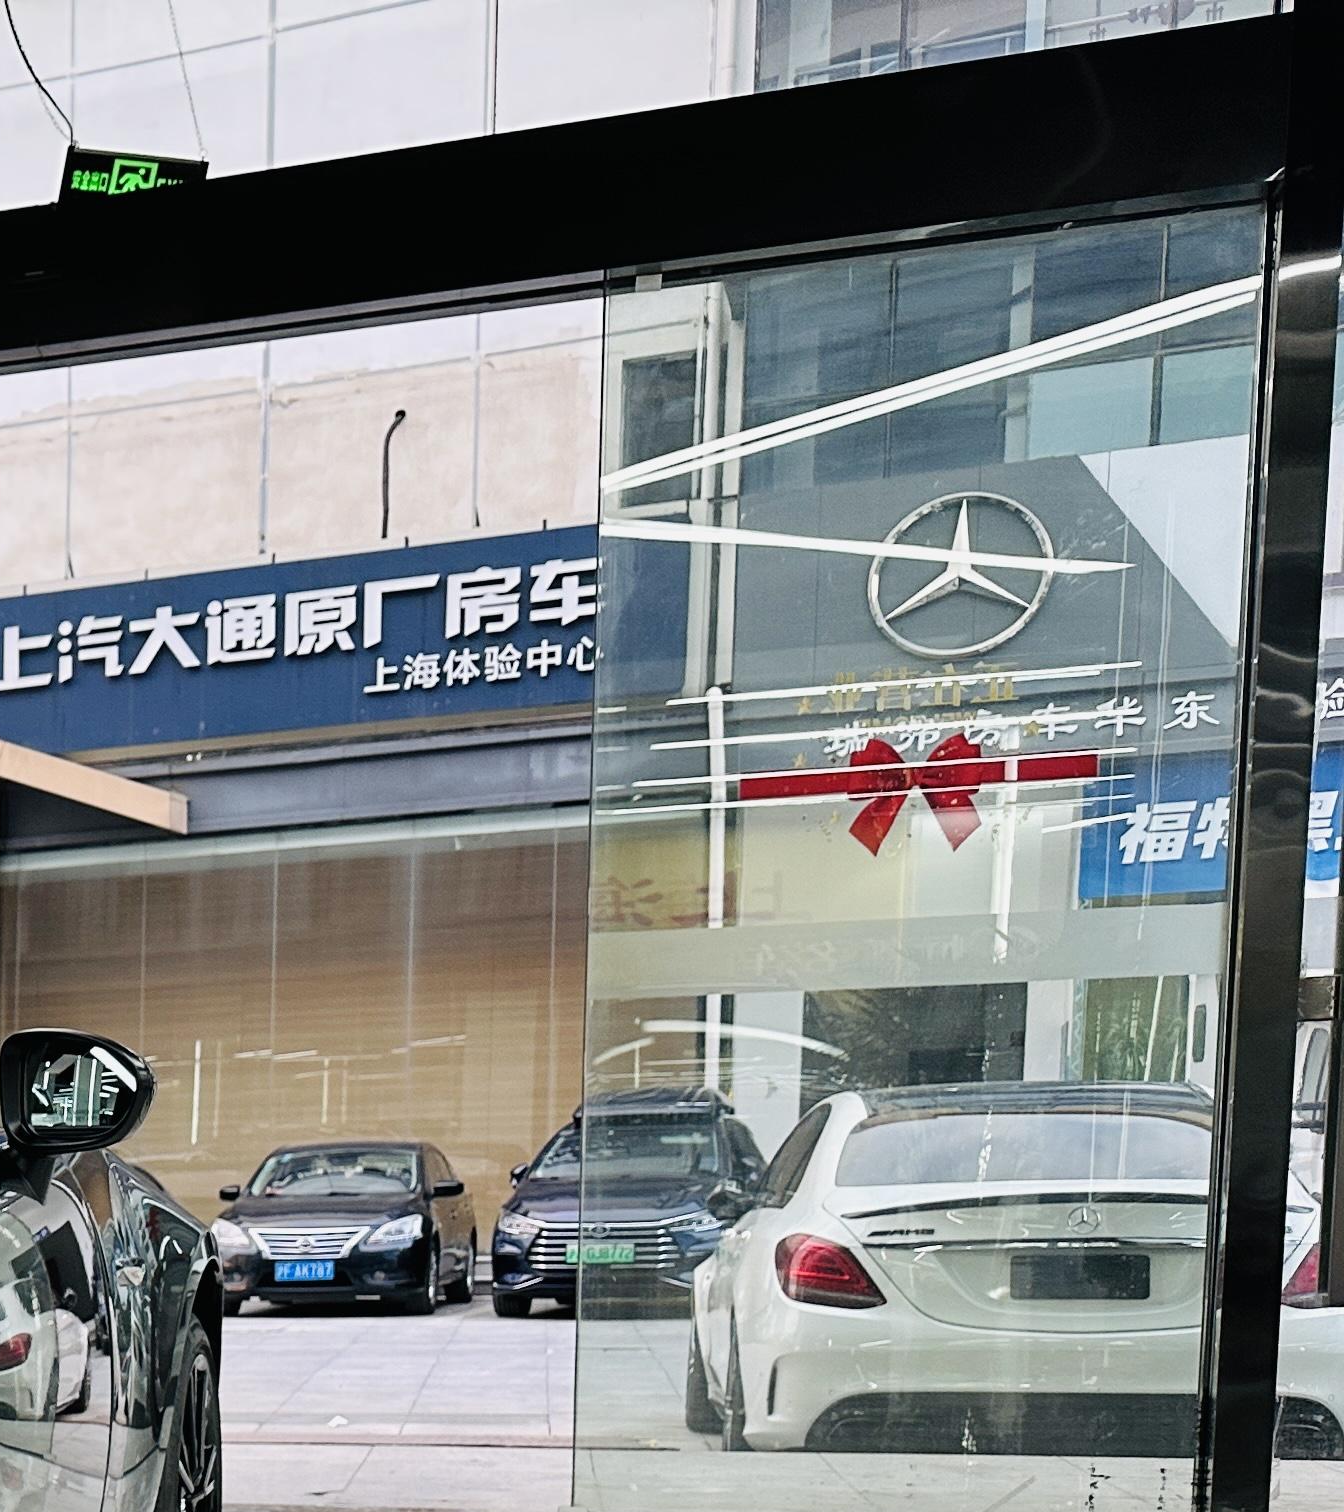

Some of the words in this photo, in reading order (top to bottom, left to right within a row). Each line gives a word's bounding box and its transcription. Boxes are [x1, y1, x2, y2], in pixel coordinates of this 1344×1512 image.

[363, 635, 603, 694] 上海体验中心
